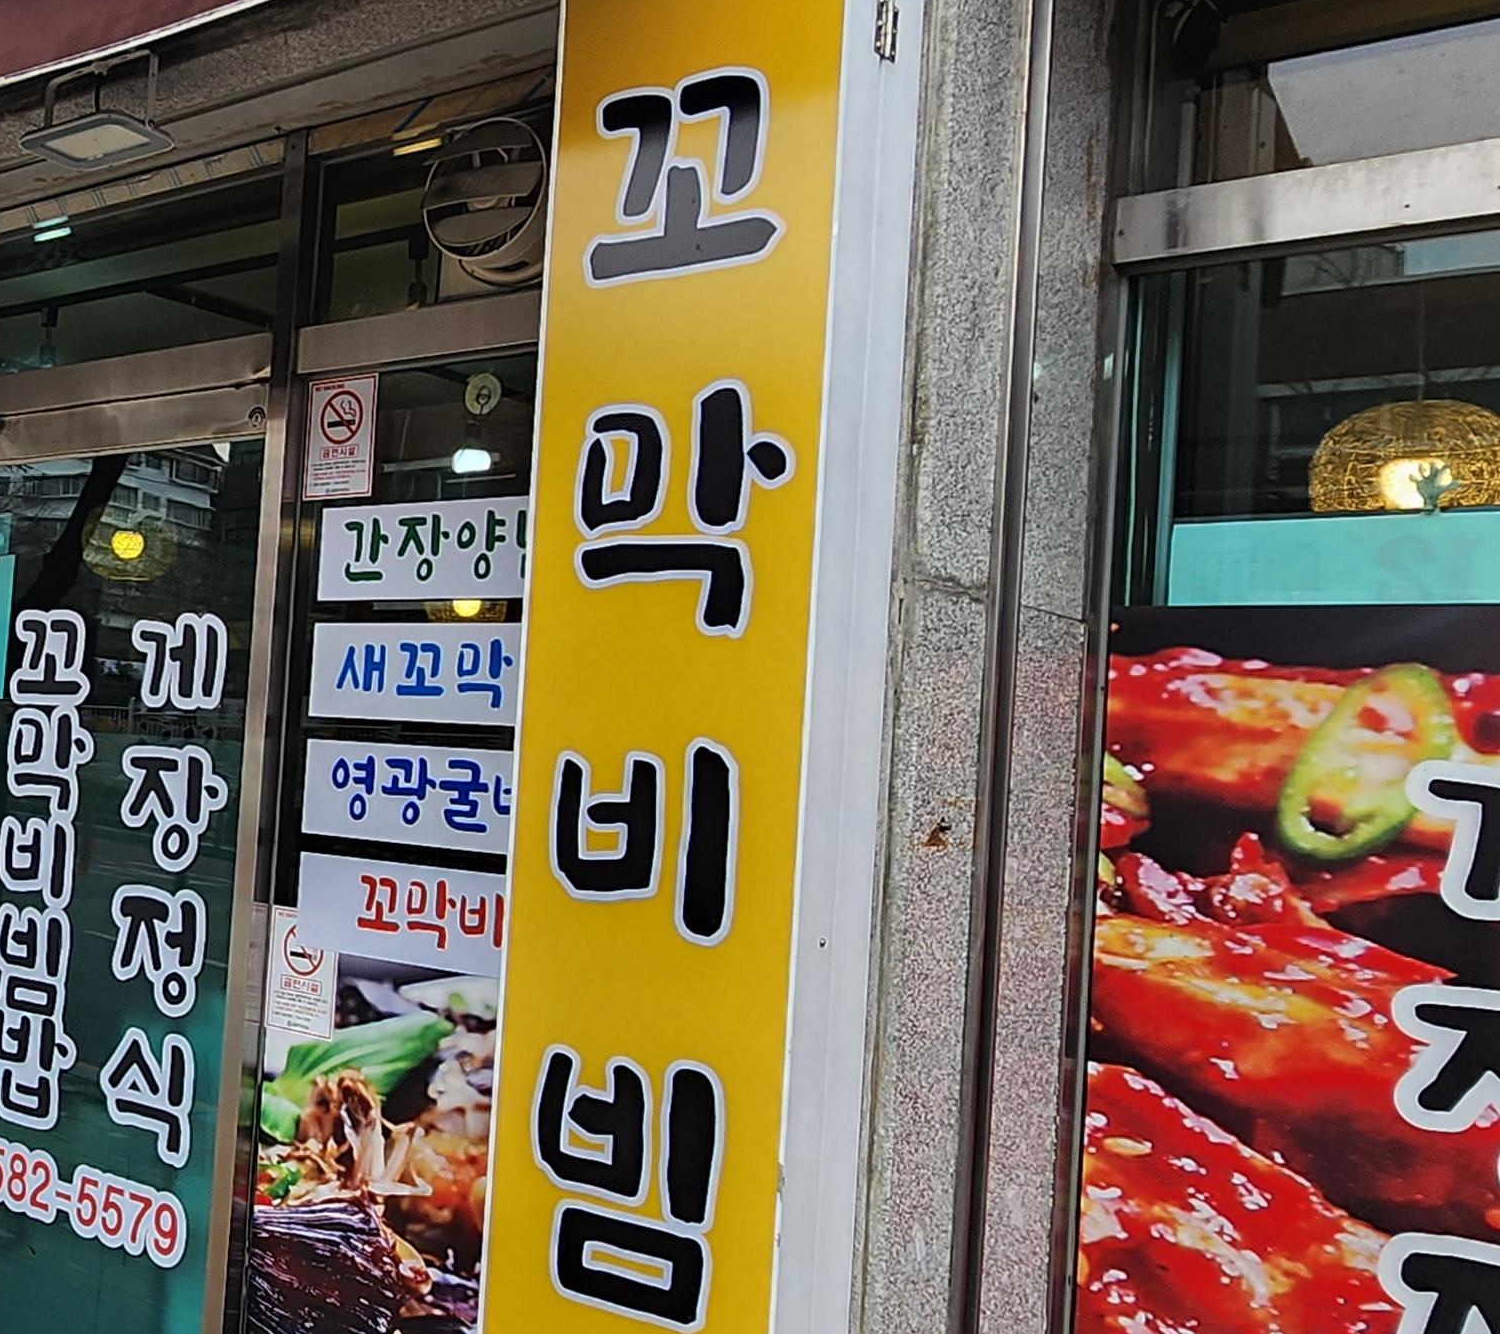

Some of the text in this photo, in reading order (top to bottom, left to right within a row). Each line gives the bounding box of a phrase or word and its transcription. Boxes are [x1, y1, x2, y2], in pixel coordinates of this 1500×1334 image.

[343, 508, 527, 583] 간장양
[335, 639, 513, 709] 새꼬막
[103, 614, 227, 1165] 게장정식
